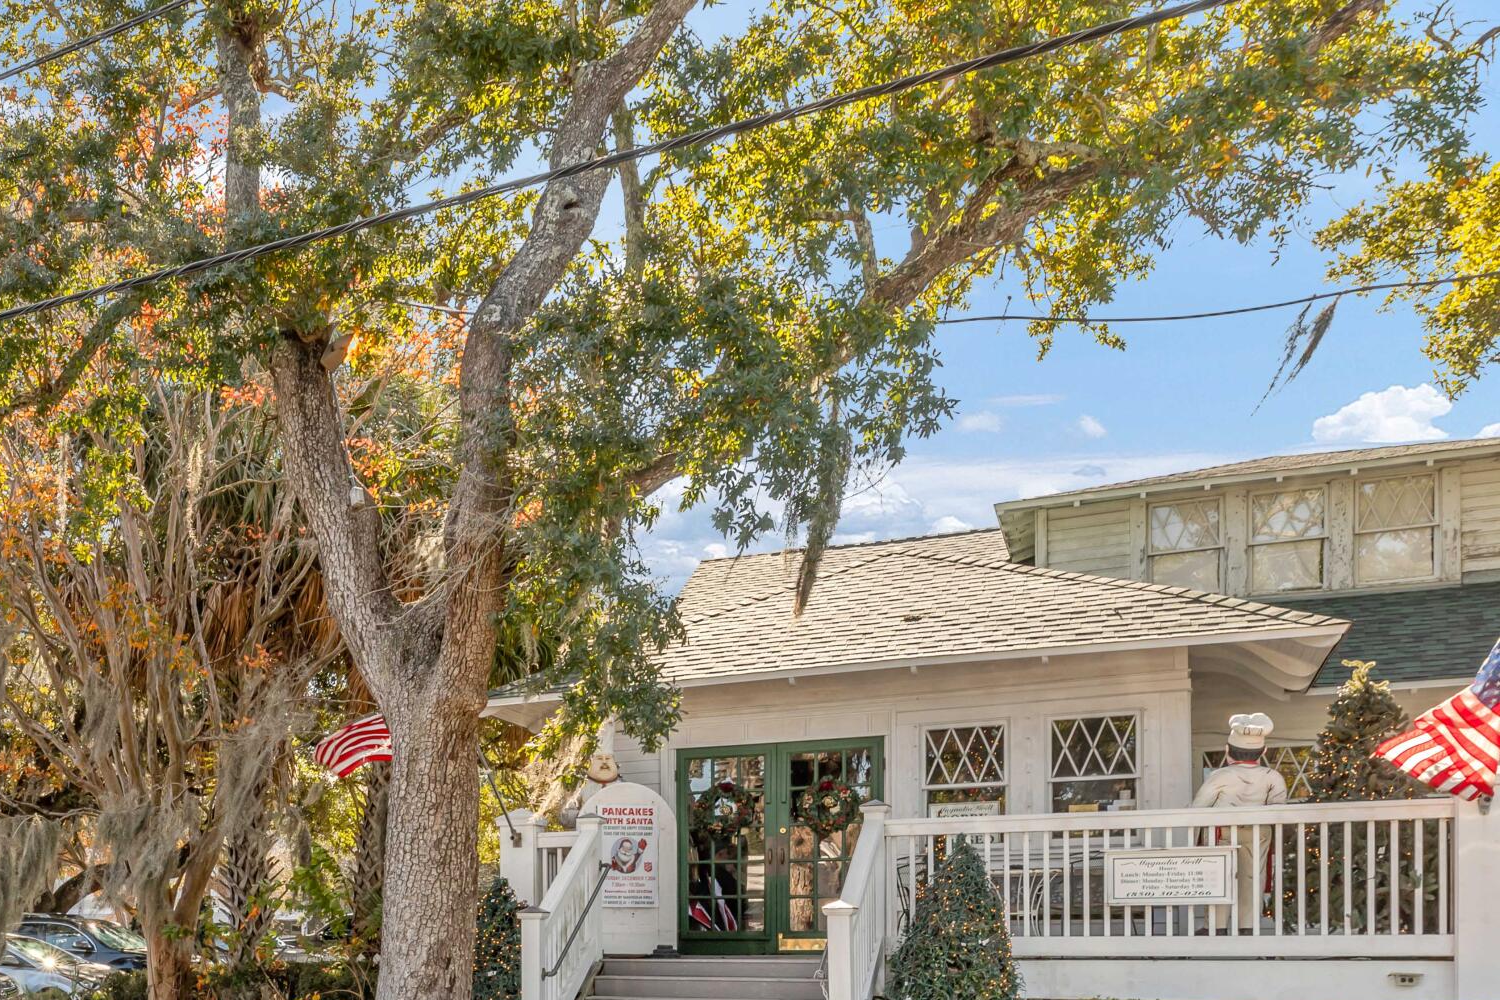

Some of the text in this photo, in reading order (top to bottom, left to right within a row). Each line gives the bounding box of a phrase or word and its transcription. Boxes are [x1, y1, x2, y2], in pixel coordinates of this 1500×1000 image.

[602, 807, 654, 816] PANCAKES
[626, 817, 653, 825] SANTA
[1139, 858, 1178, 868] Magnolia
